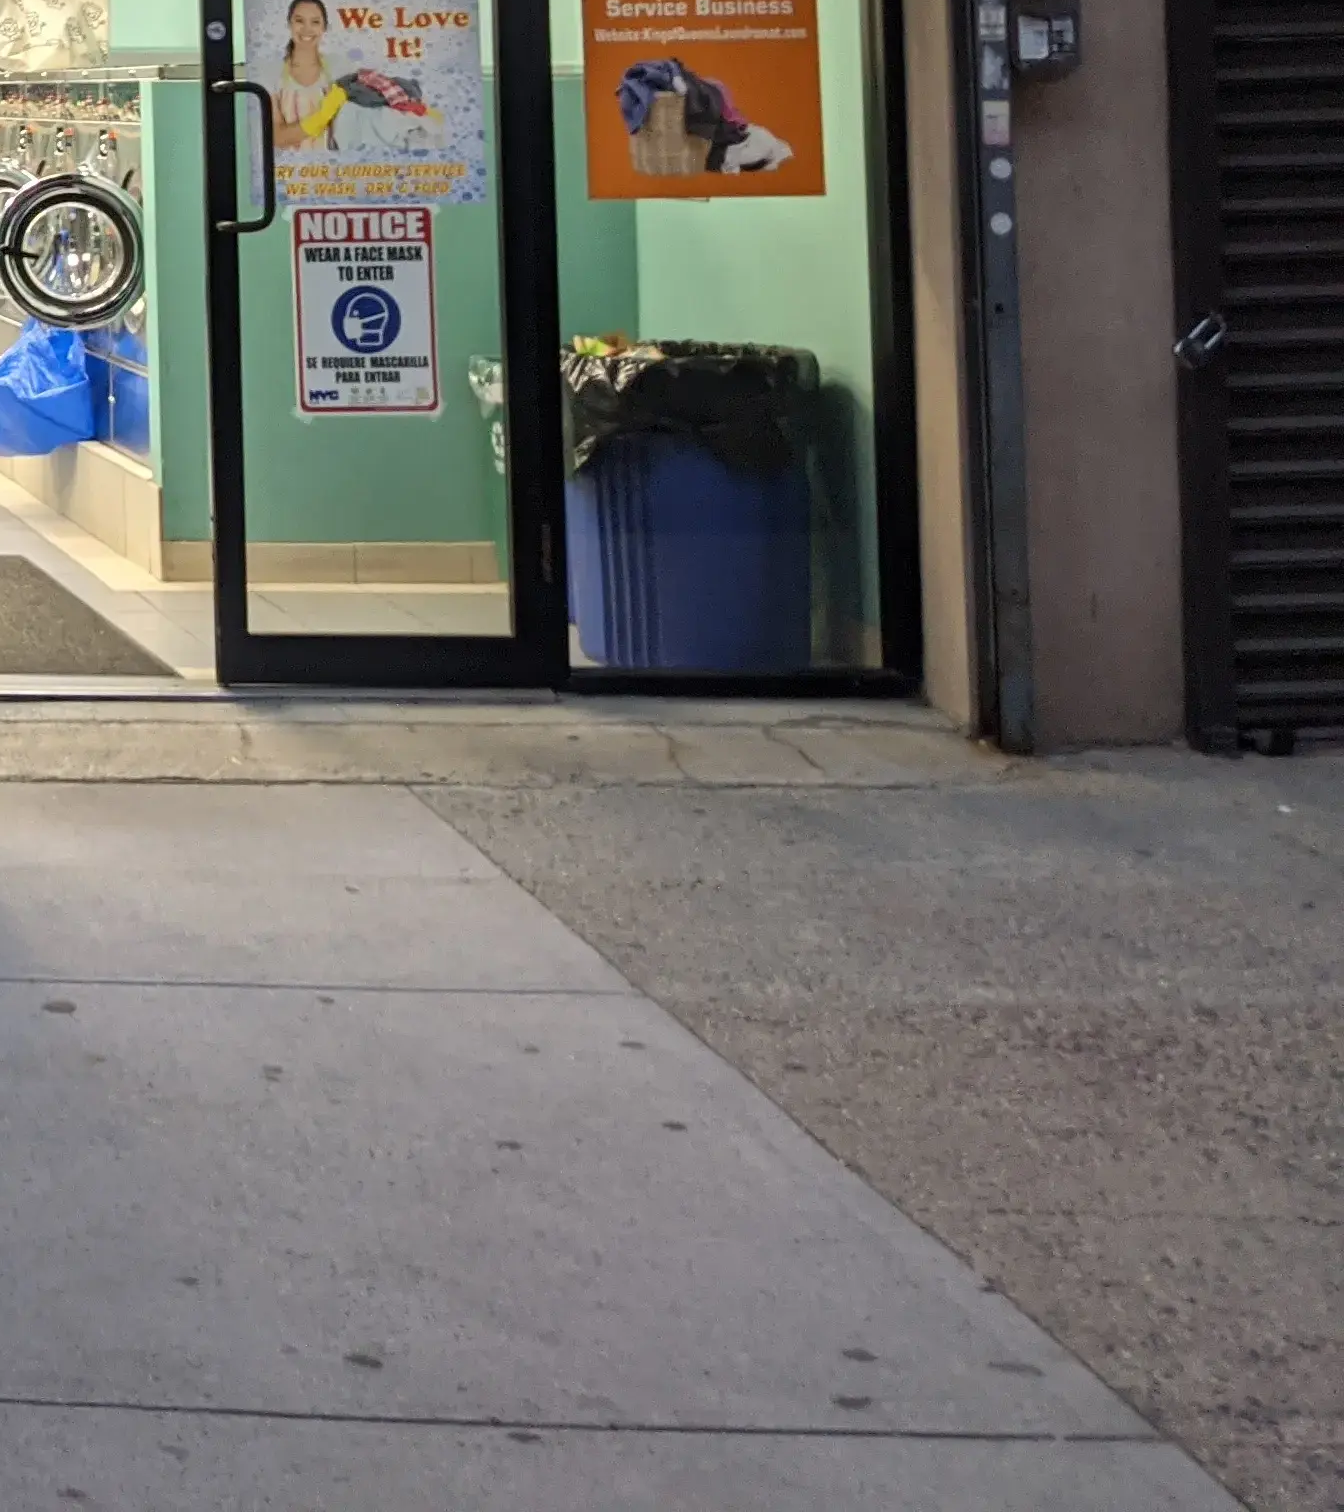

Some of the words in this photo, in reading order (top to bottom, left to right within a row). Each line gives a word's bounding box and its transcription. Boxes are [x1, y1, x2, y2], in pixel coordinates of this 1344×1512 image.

[337, 6, 384, 29] We
[395, 6, 470, 29] Love
[386, 37, 423, 59] It!
[274, 164, 294, 179] RY
[299, 211, 426, 241] NOTICE
[304, 247, 342, 263] WEAR
[344, 247, 354, 262] A
[354, 246, 385, 262] FACE
[387, 246, 424, 262] MASK
[337, 266, 354, 281] TO
[356, 265, 394, 281] ENTER
[306, 356, 318, 369] SE
[321, 356, 365, 369] REQUIERE
[369, 356, 429, 369] MASCARILLA
[335, 371, 360, 383] PARA
[364, 371, 401, 383] ENTRAR
[309, 389, 340, 401] NYC
